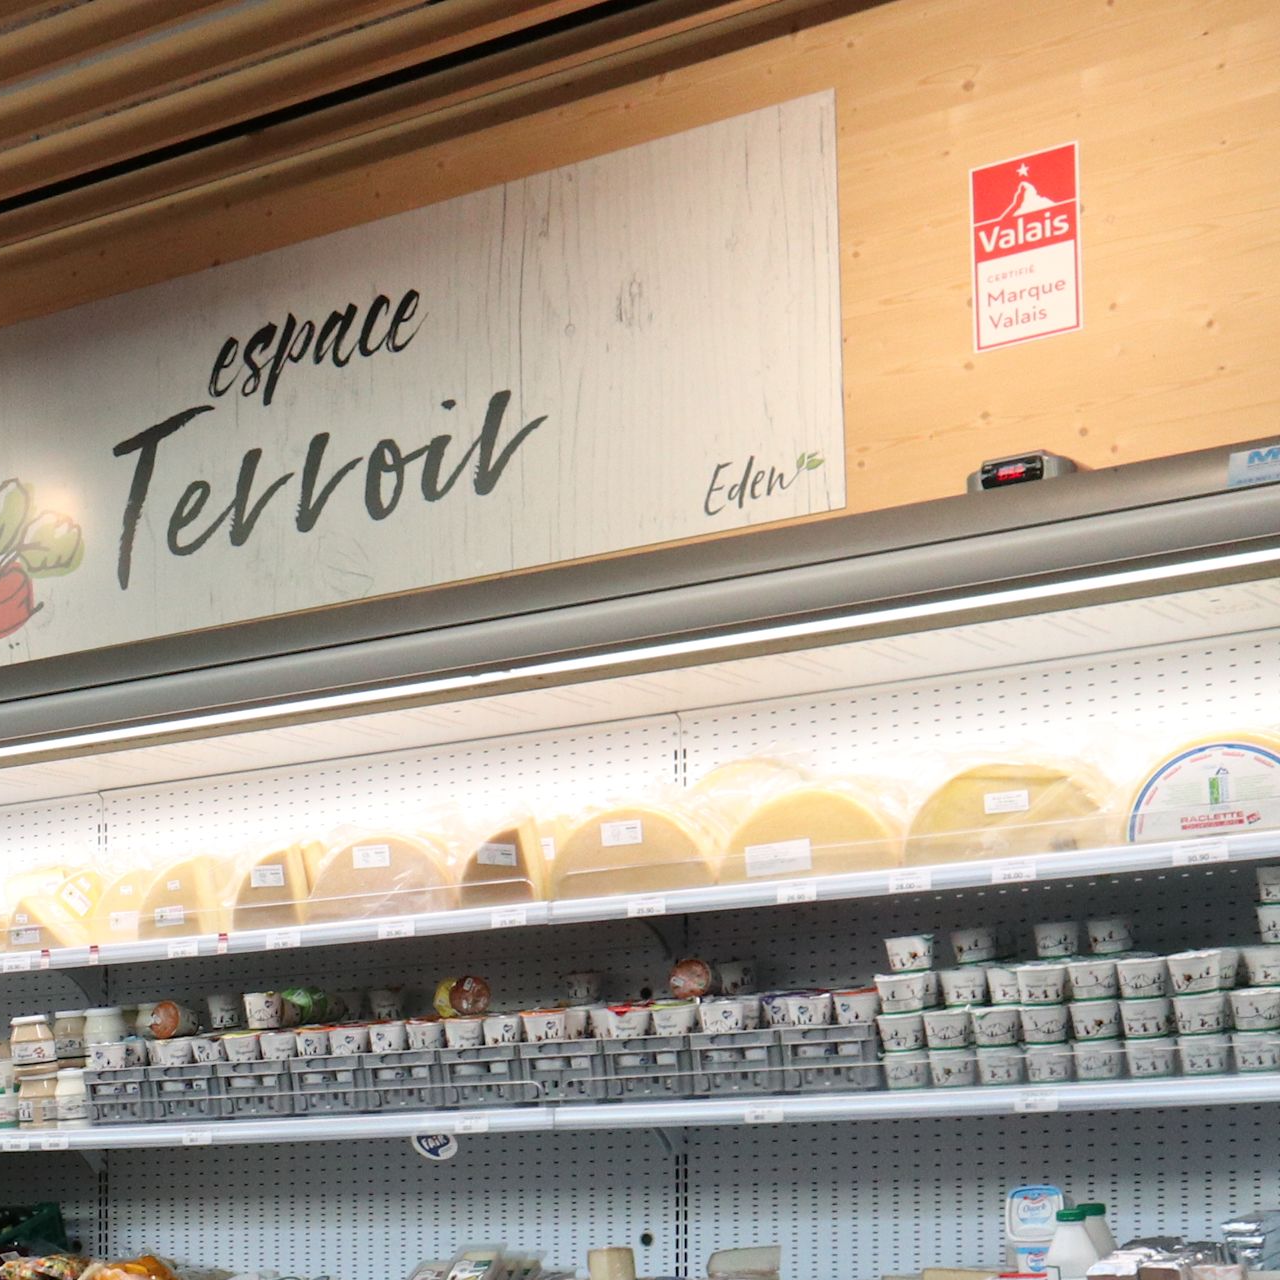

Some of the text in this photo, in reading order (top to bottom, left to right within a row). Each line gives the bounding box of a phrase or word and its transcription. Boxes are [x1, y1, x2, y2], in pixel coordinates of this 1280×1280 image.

[979, 212, 1070, 253] Valais
[987, 278, 1067, 308] Marque
[989, 306, 1048, 331] Valais
[208, 288, 427, 407] espace
[112, 388, 549, 591] Terroir
[704, 455, 794, 516] Eden
